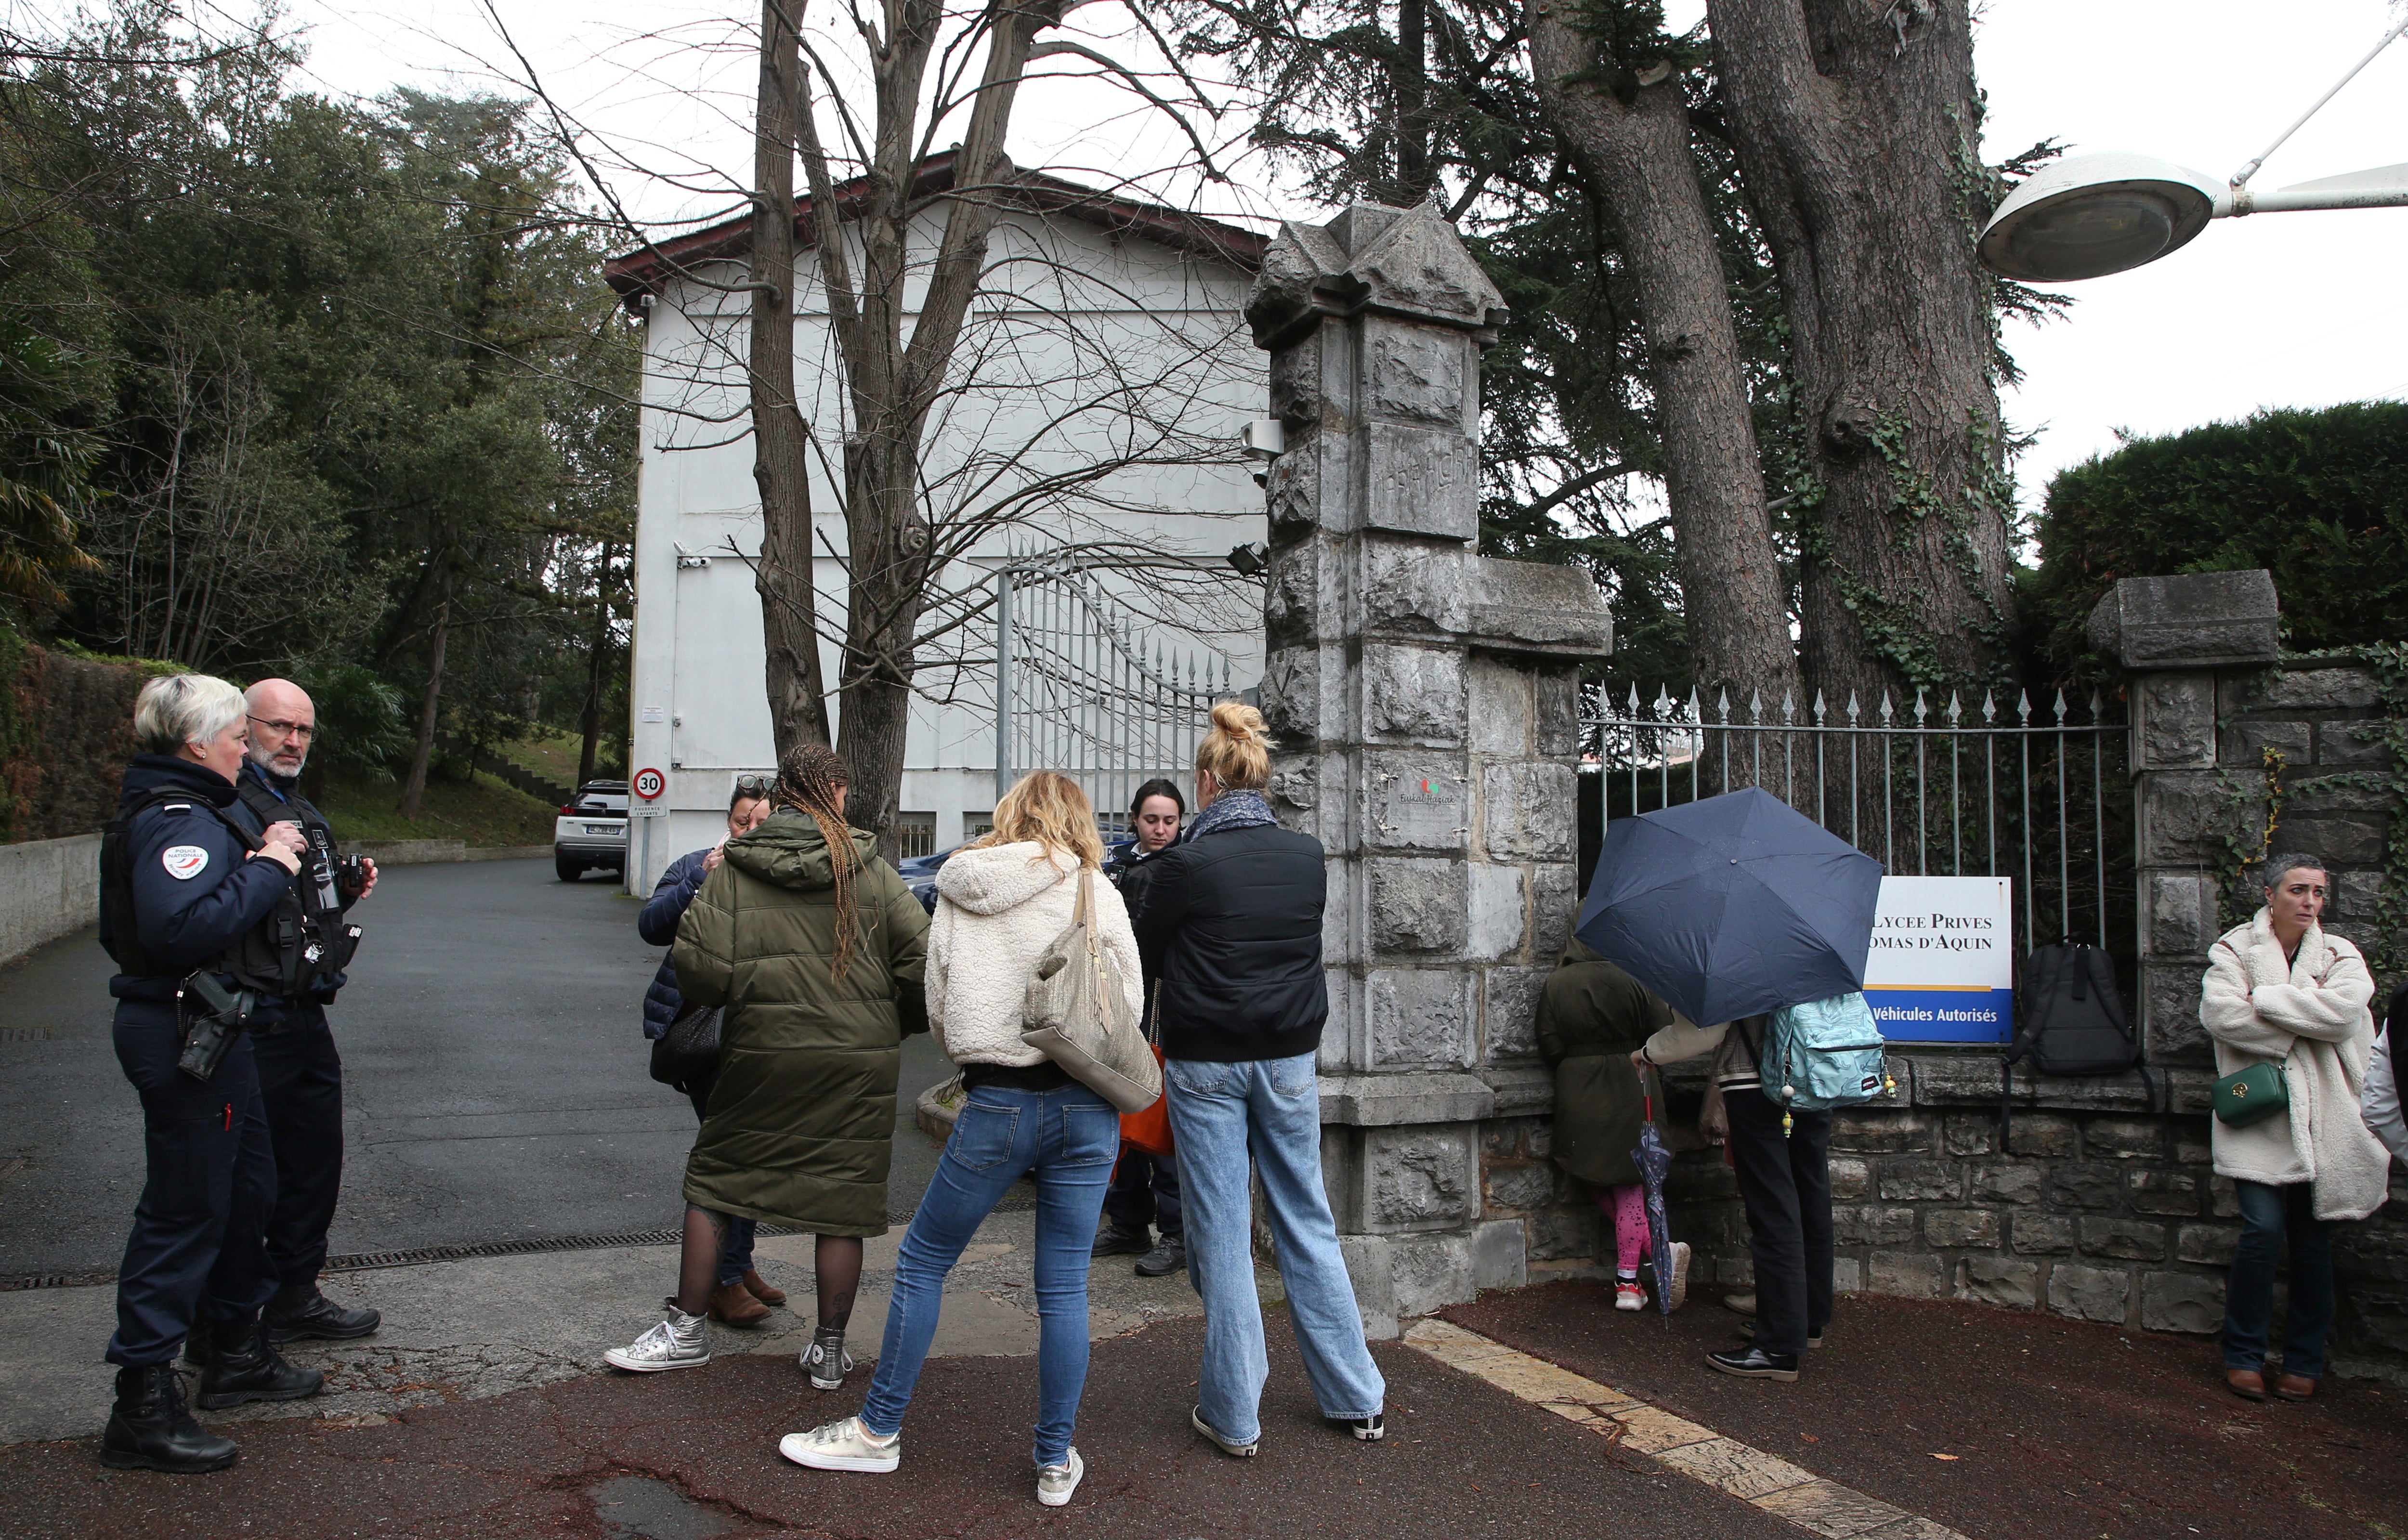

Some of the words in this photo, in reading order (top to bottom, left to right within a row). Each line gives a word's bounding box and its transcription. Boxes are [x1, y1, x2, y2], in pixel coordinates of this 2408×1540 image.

[640, 777, 658, 790] 30
[1400, 793, 1425, 803] Euskal
[1426, 794, 1456, 806] Haziak
[1872, 913, 1926, 928] LYCEE
[1930, 913, 1992, 929] PRIVES
[1869, 937, 1913, 949] OMAS
[1918, 934, 1992, 952] D'AQUIN
[1872, 1006, 1933, 1021] Véhicules
[1937, 1007, 1998, 1022] Autorisés
